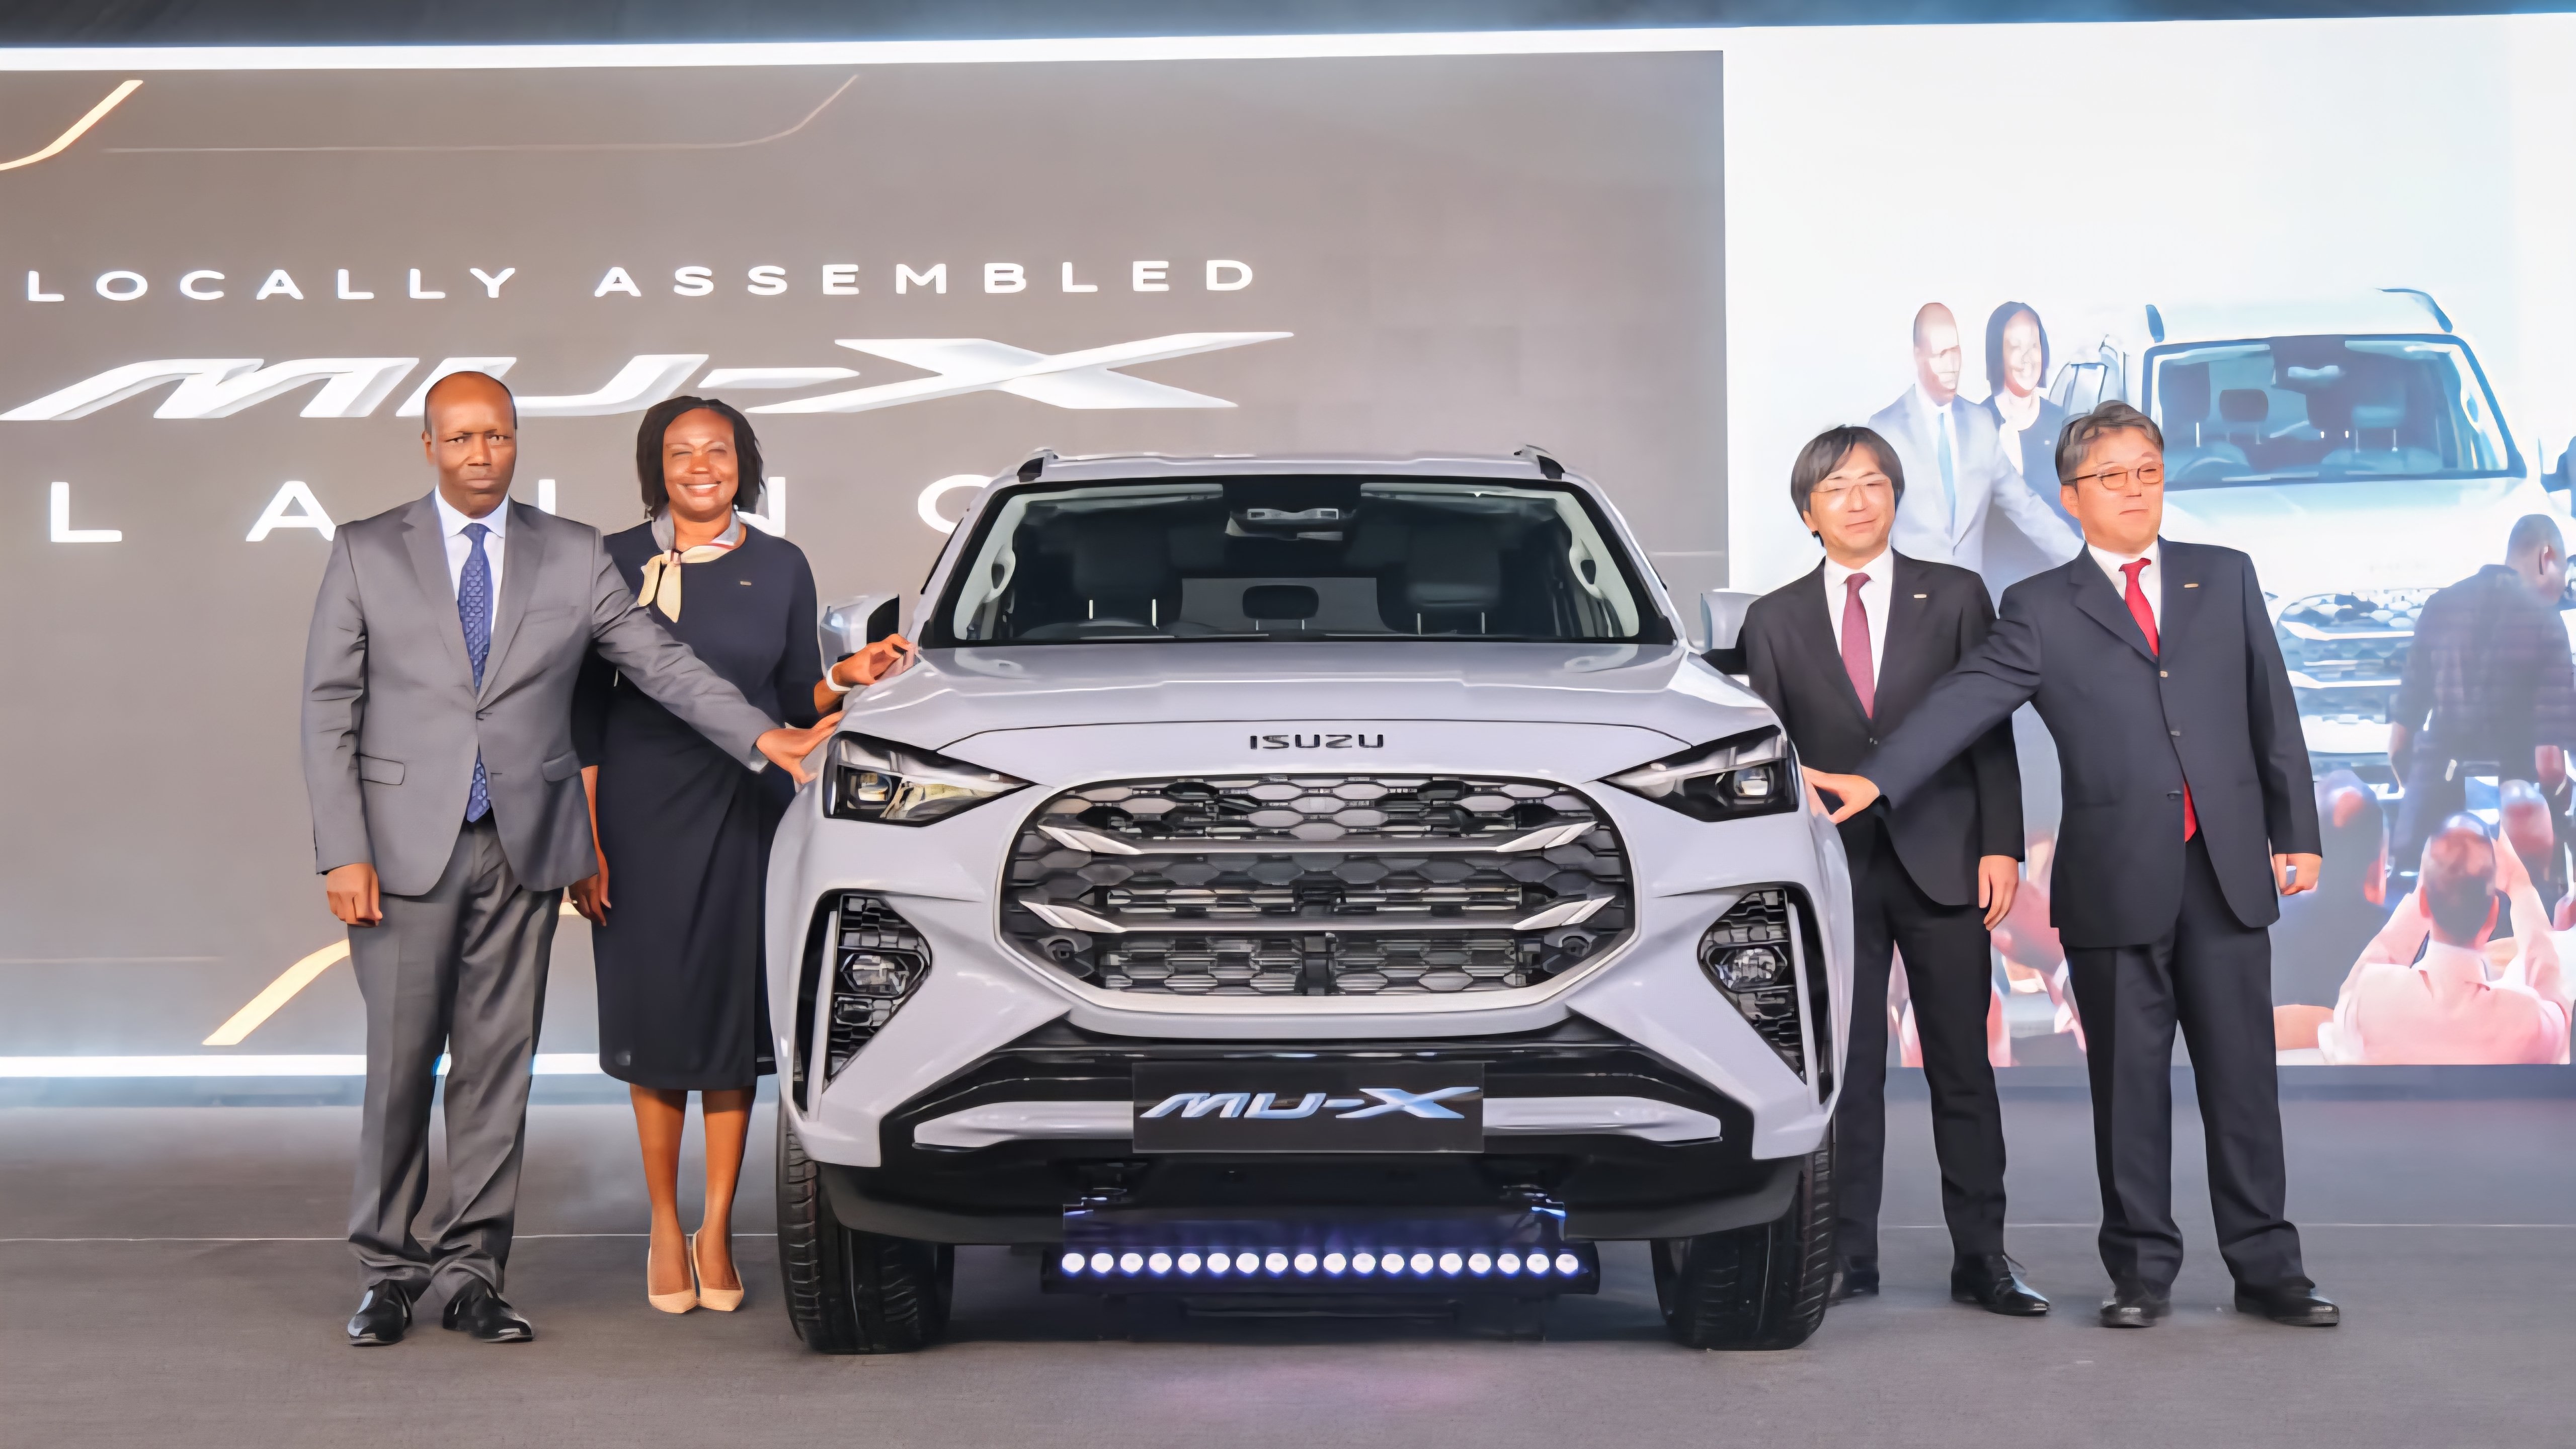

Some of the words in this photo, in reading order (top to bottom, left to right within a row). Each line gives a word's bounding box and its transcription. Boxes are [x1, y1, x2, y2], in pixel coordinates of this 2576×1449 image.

[27, 267, 516, 302] LOCALLY
[594, 259, 1253, 297] ASSEMBLED
[1250, 734, 1384, 749] ISUZU
[1140, 1086, 1480, 1119] MU-X
